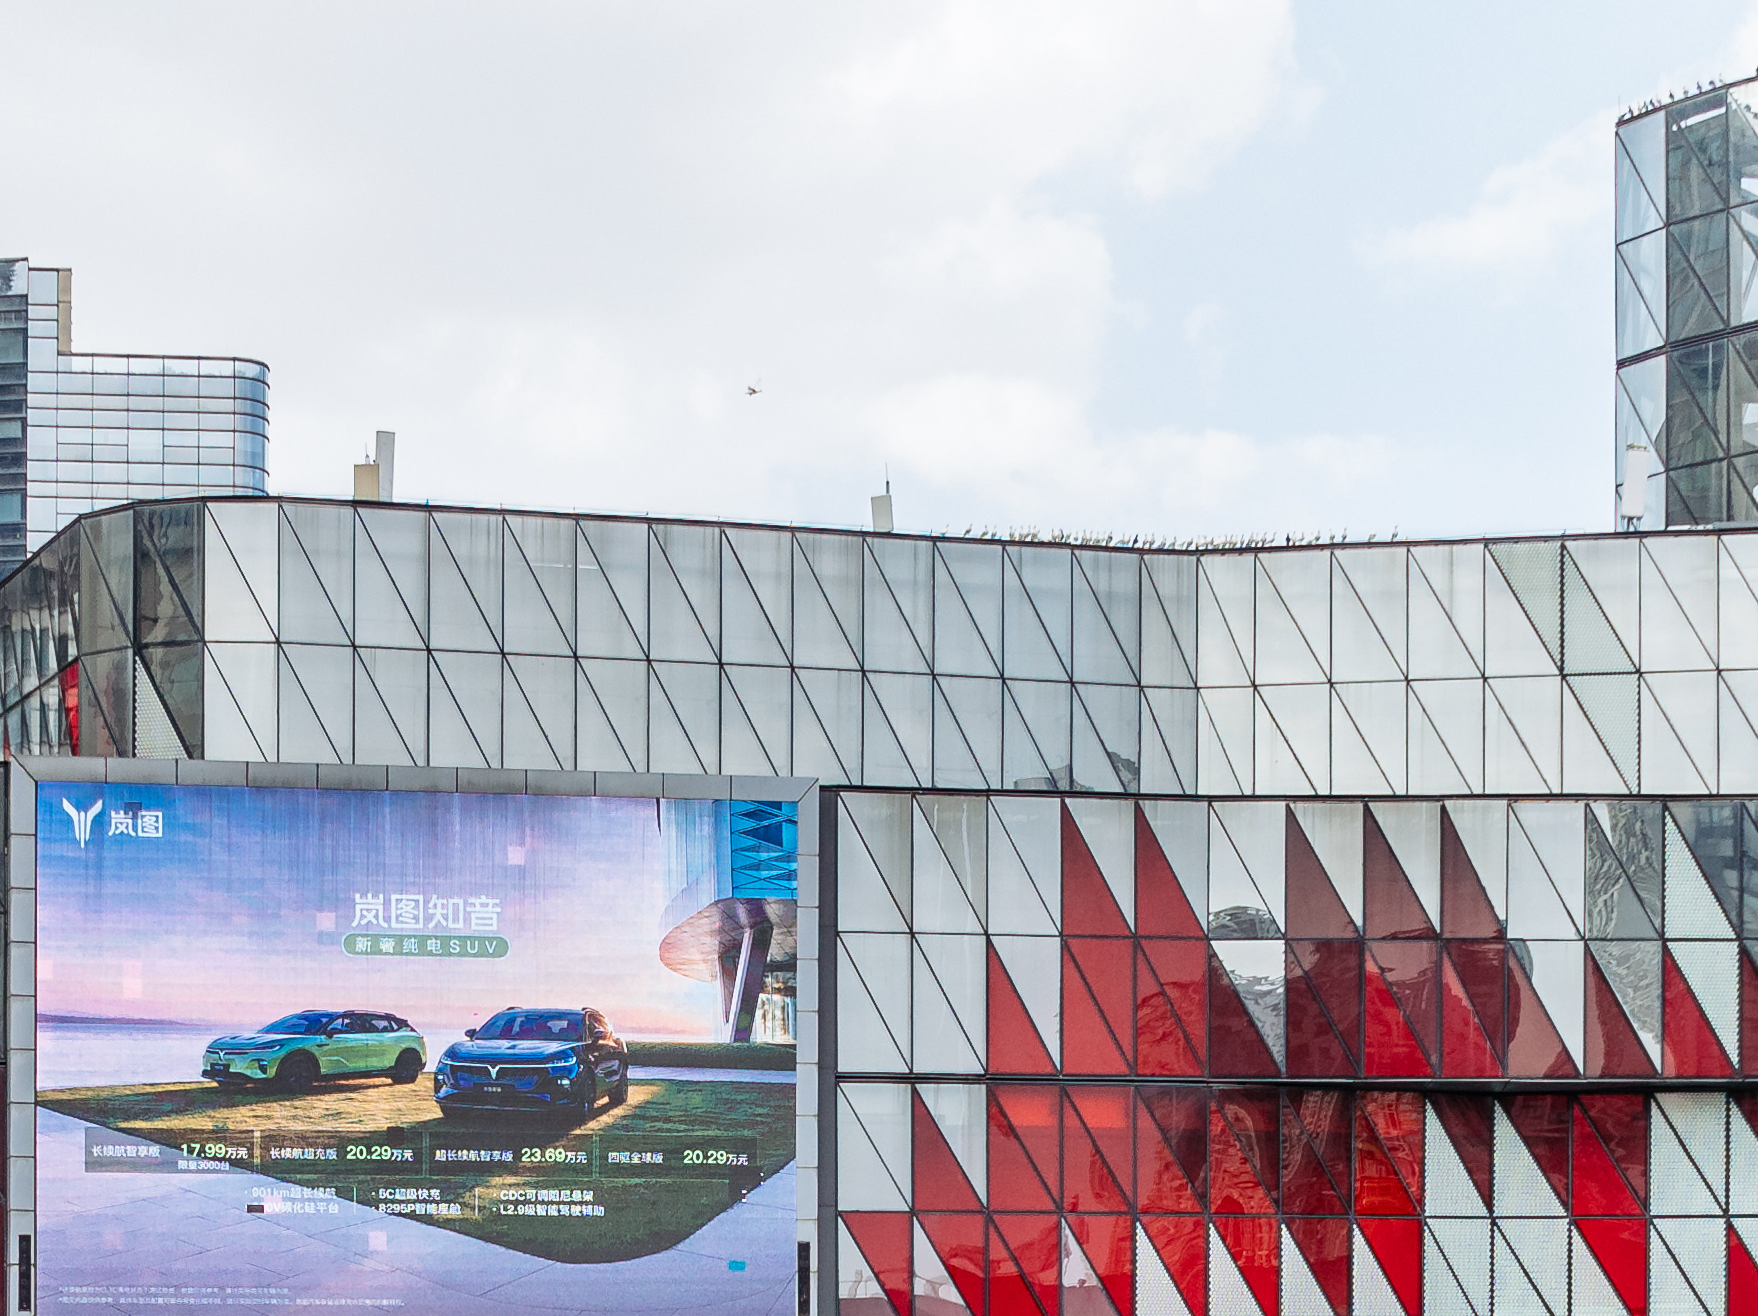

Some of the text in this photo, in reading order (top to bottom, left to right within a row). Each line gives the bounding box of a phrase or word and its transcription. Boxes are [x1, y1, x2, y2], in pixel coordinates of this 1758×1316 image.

[108, 809, 163, 838] 岚图
[351, 893, 502, 931] 岚图知音
[355, 936, 499, 955] 新奢纯电SUV
[180, 1143, 249, 1159] 17.99万元
[346, 1145, 415, 1162] 20.29万元
[521, 1148, 588, 1164] 23.69万元
[683, 1150, 749, 1166] 20.29万元
